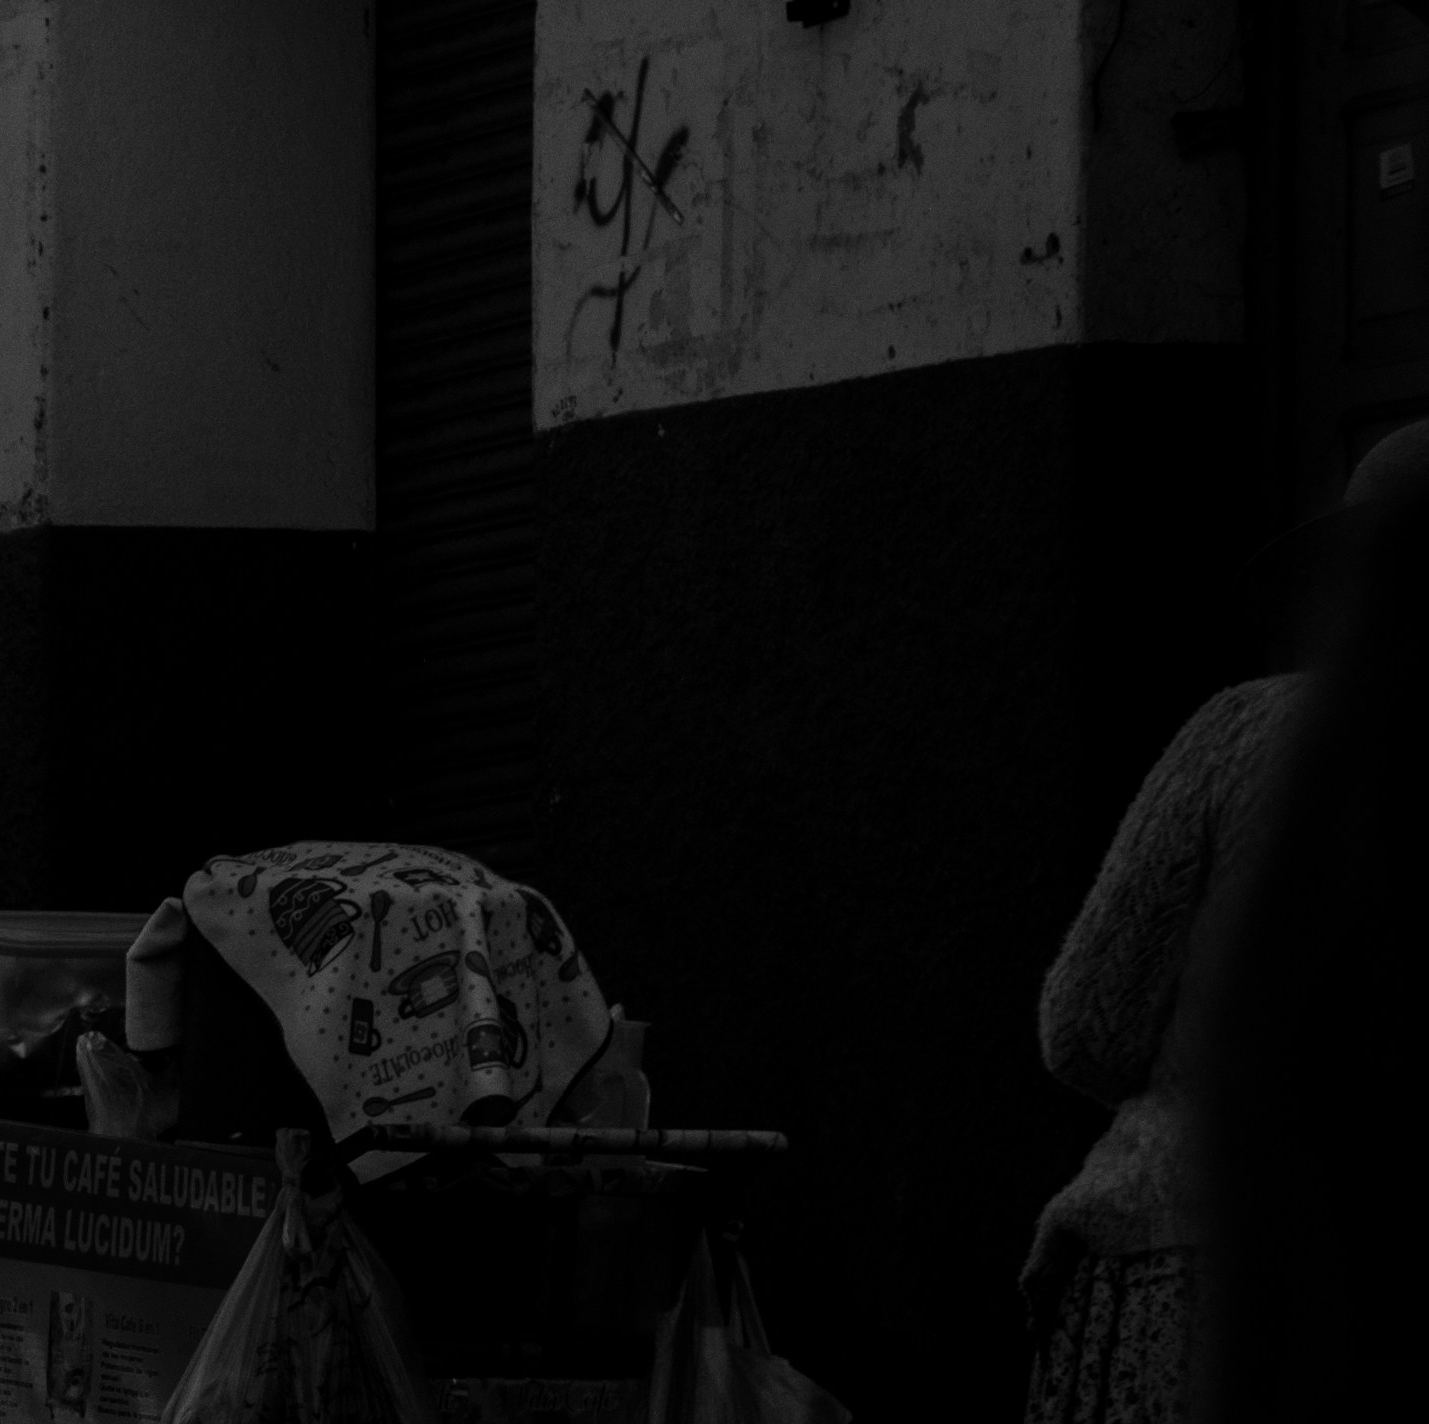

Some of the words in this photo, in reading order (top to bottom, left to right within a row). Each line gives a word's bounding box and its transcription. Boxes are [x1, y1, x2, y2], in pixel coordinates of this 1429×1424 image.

[25, 1144, 55, 1189] TU
[62, 1147, 120, 1199] CAFÉ
[128, 1163, 269, 1218] SALUDABLE
[64, 1205, 186, 1265] LUCIDUM?
